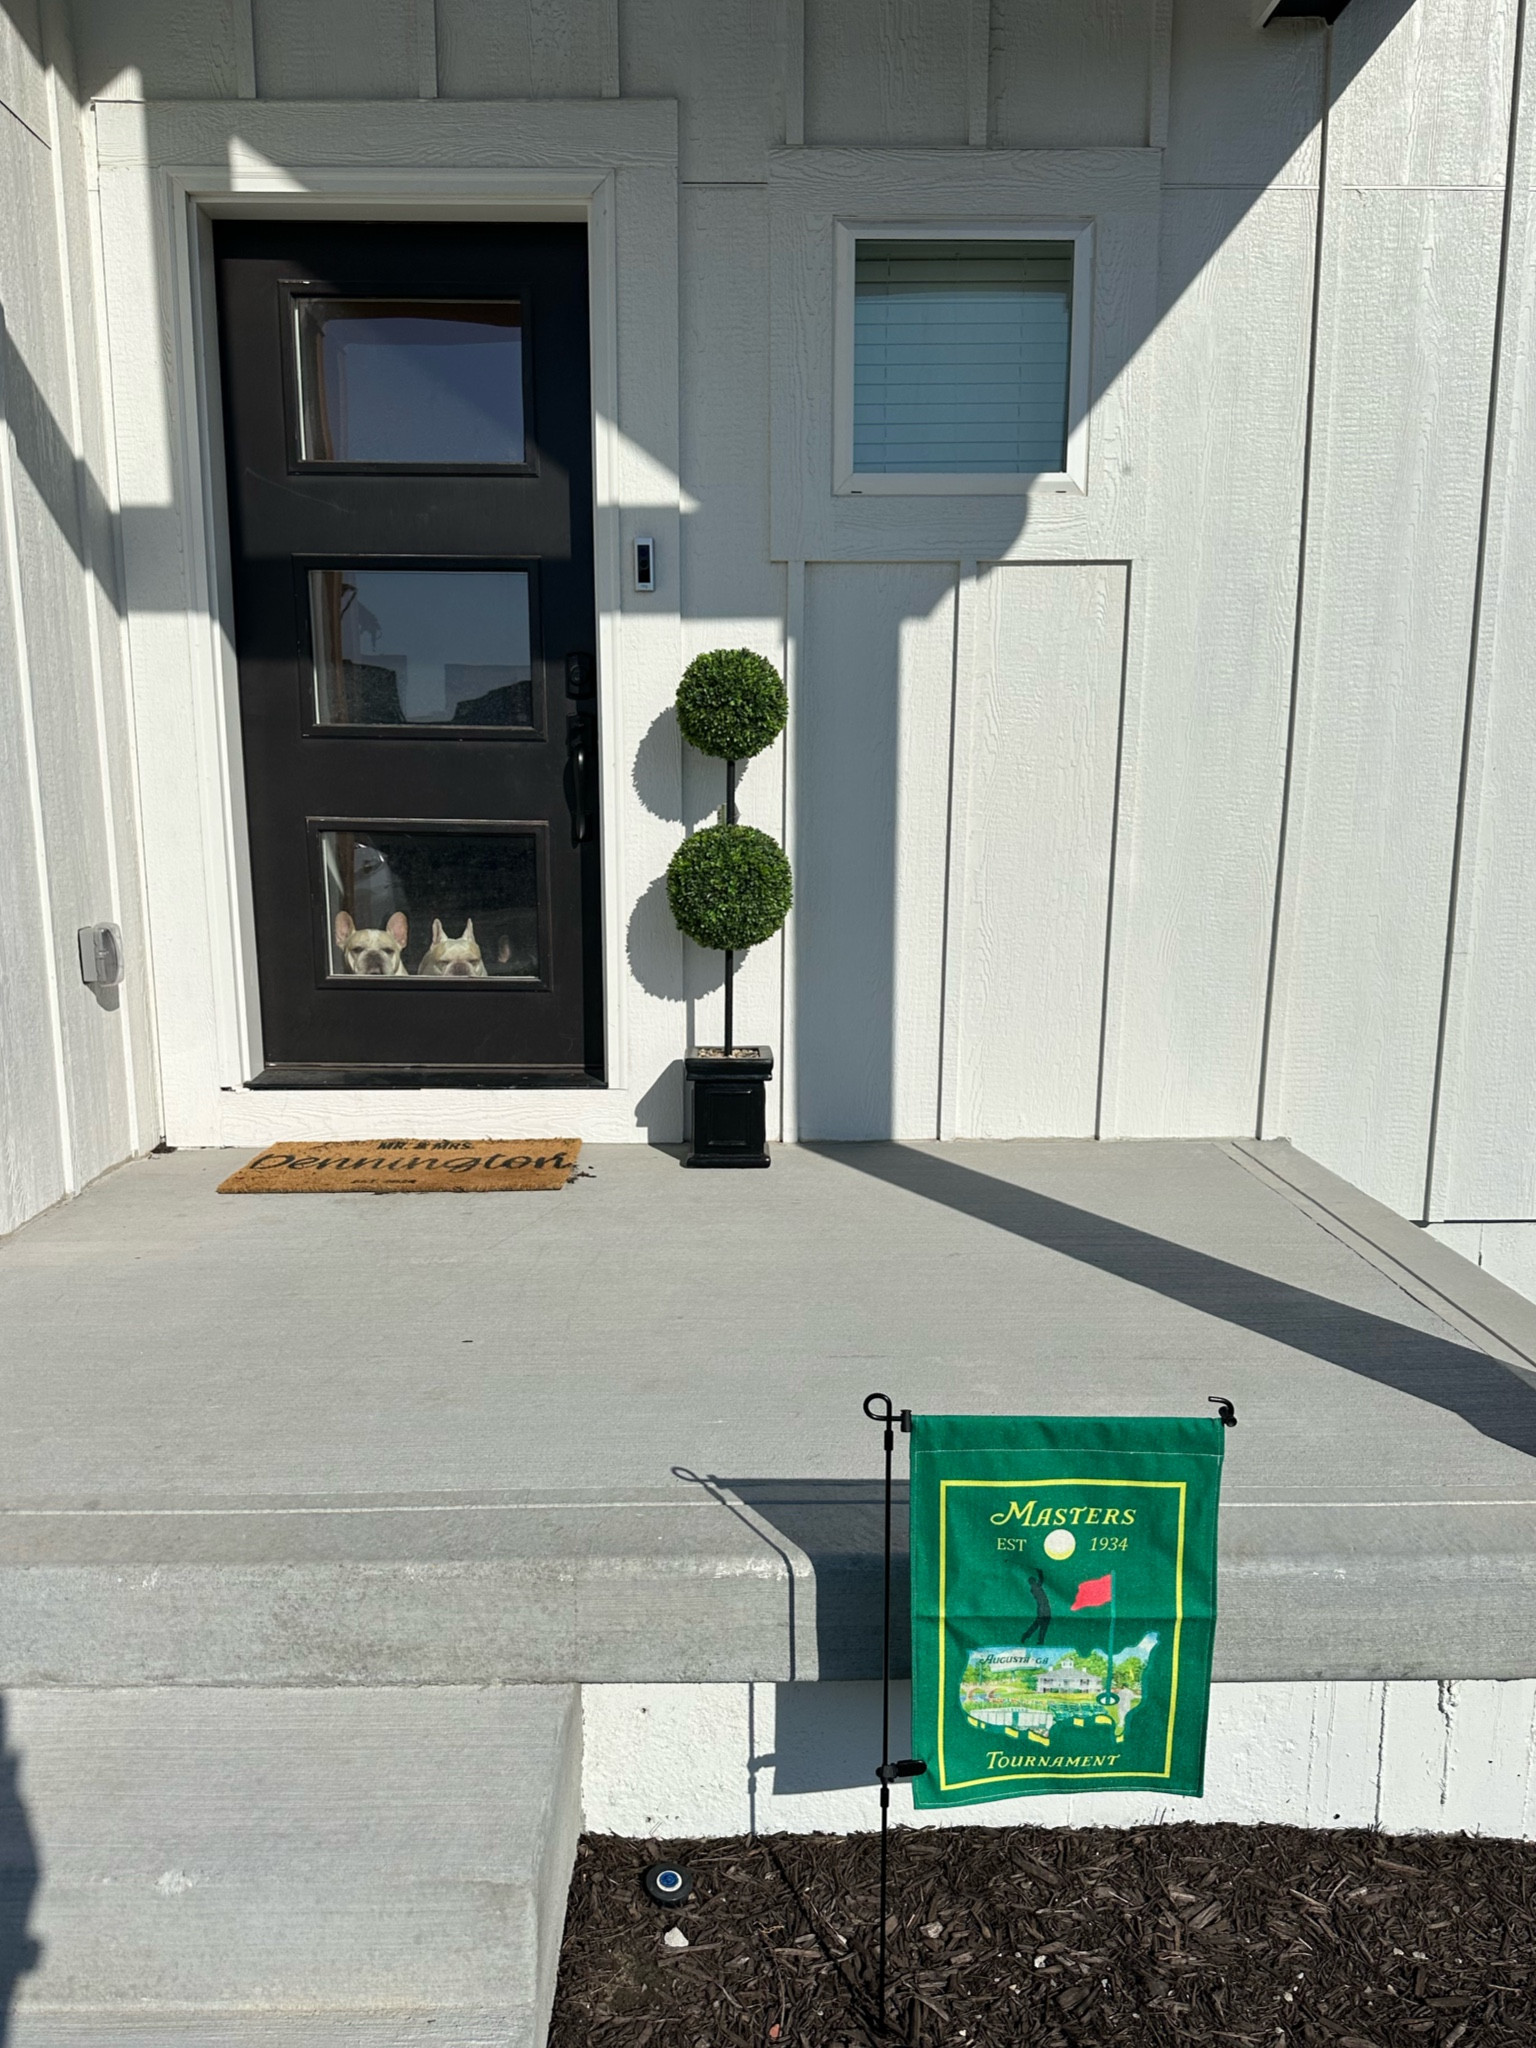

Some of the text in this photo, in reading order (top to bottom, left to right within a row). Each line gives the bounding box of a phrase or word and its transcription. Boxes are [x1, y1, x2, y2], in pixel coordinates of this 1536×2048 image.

[996, 1537, 1129, 1552] EST 1934
[986, 1751, 1121, 1769] TOURNAMENT
